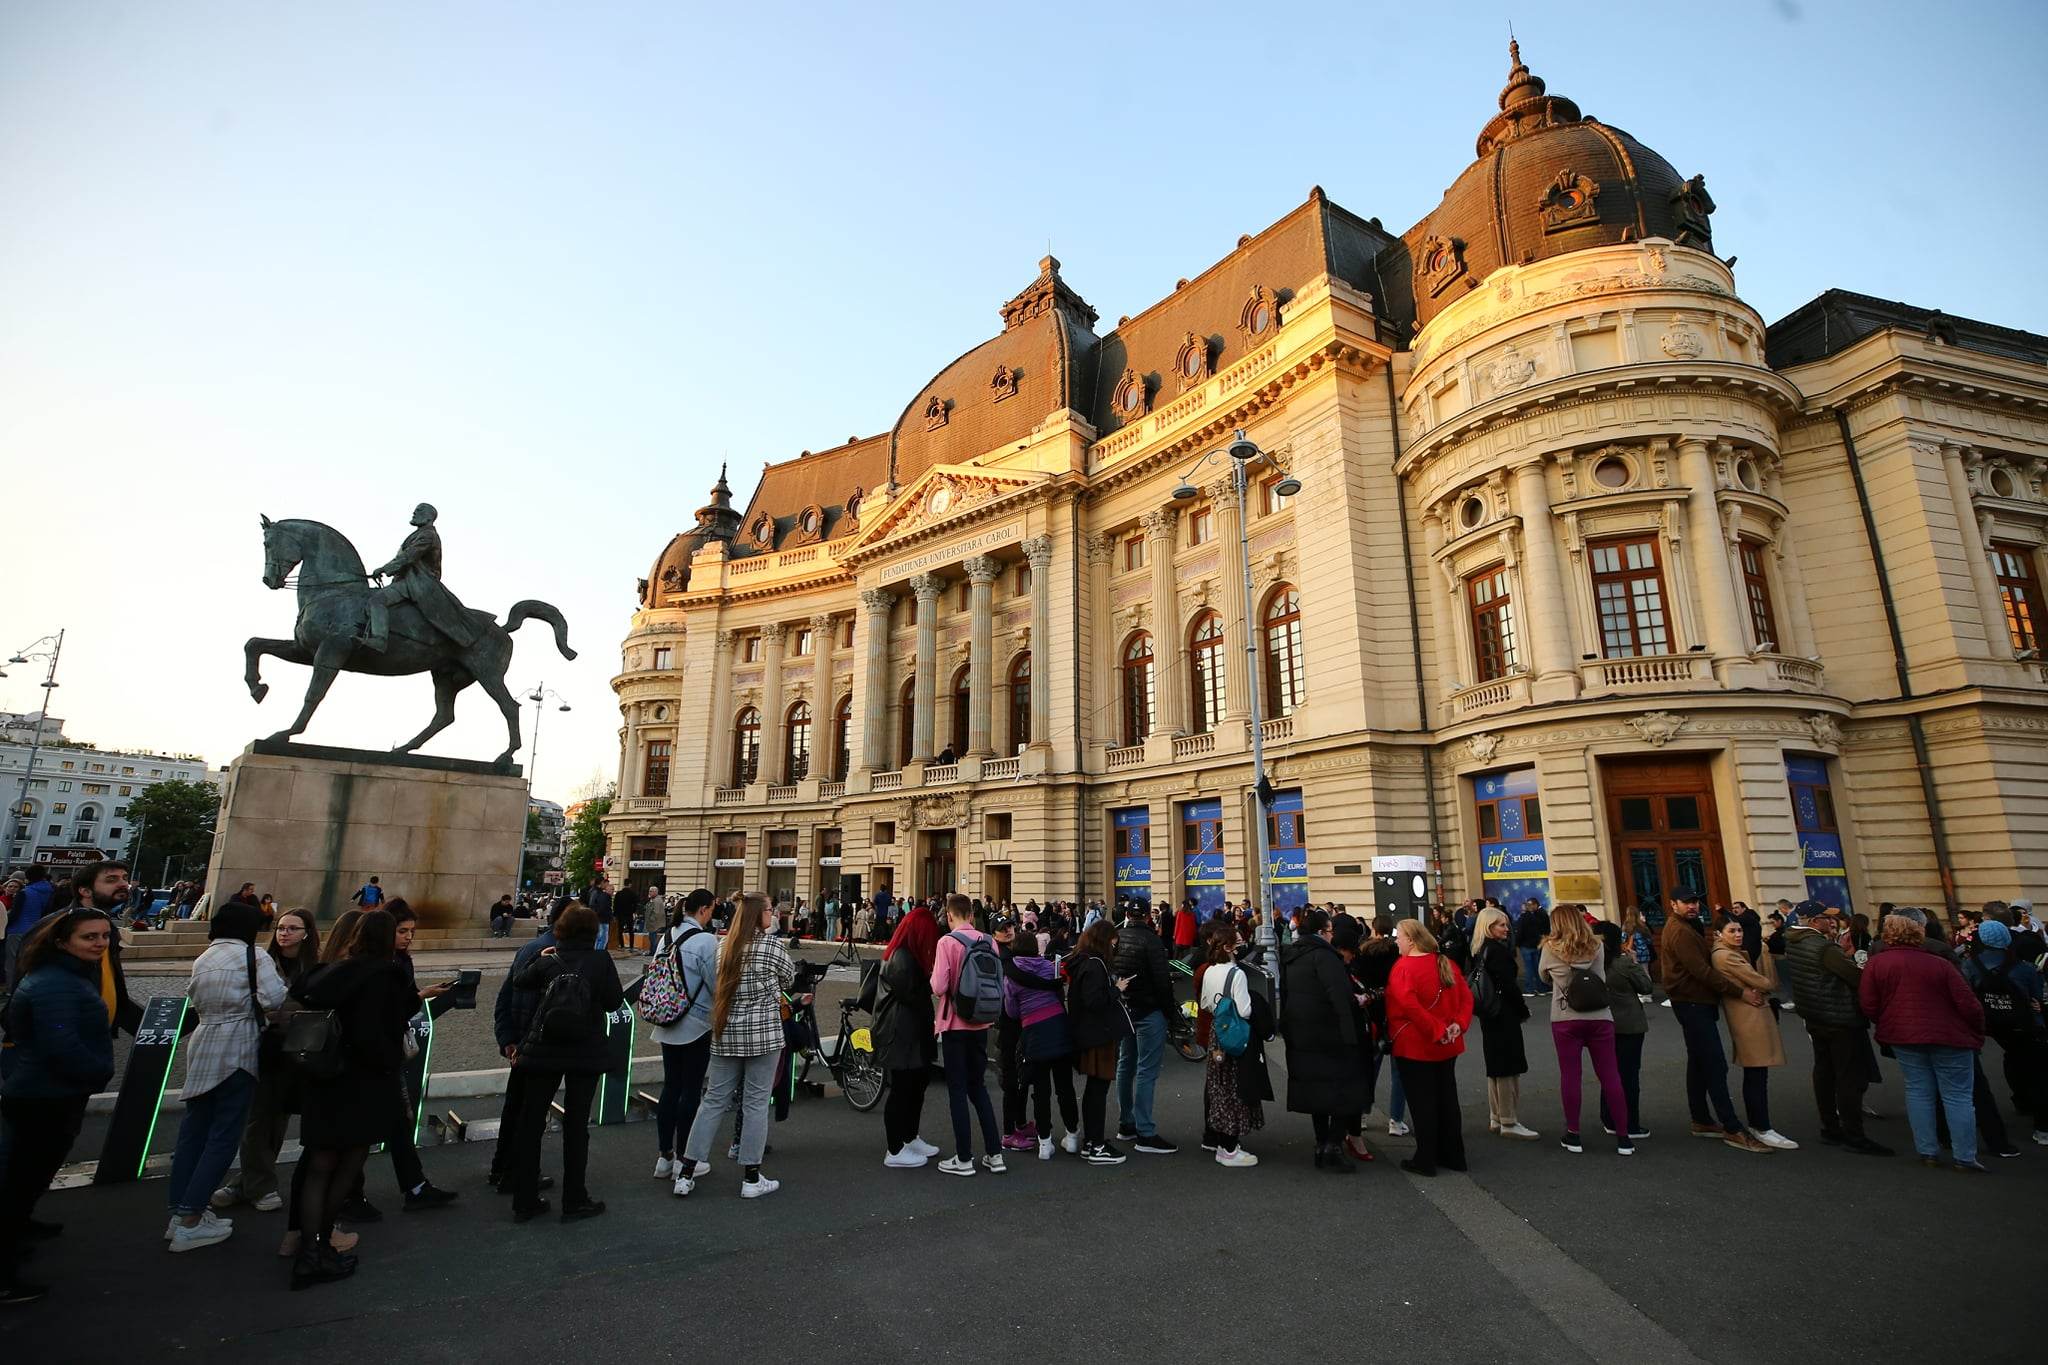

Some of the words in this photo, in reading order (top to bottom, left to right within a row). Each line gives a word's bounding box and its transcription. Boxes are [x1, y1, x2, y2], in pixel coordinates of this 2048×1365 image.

[986, 528, 1014, 545] CAROL
[610, 1015, 620, 1024] 18
[622, 1015, 632, 1023] 17
[418, 1027, 430, 1037] 19
[135, 1034, 157, 1045] 22
[158, 1034, 176, 1045] 21
